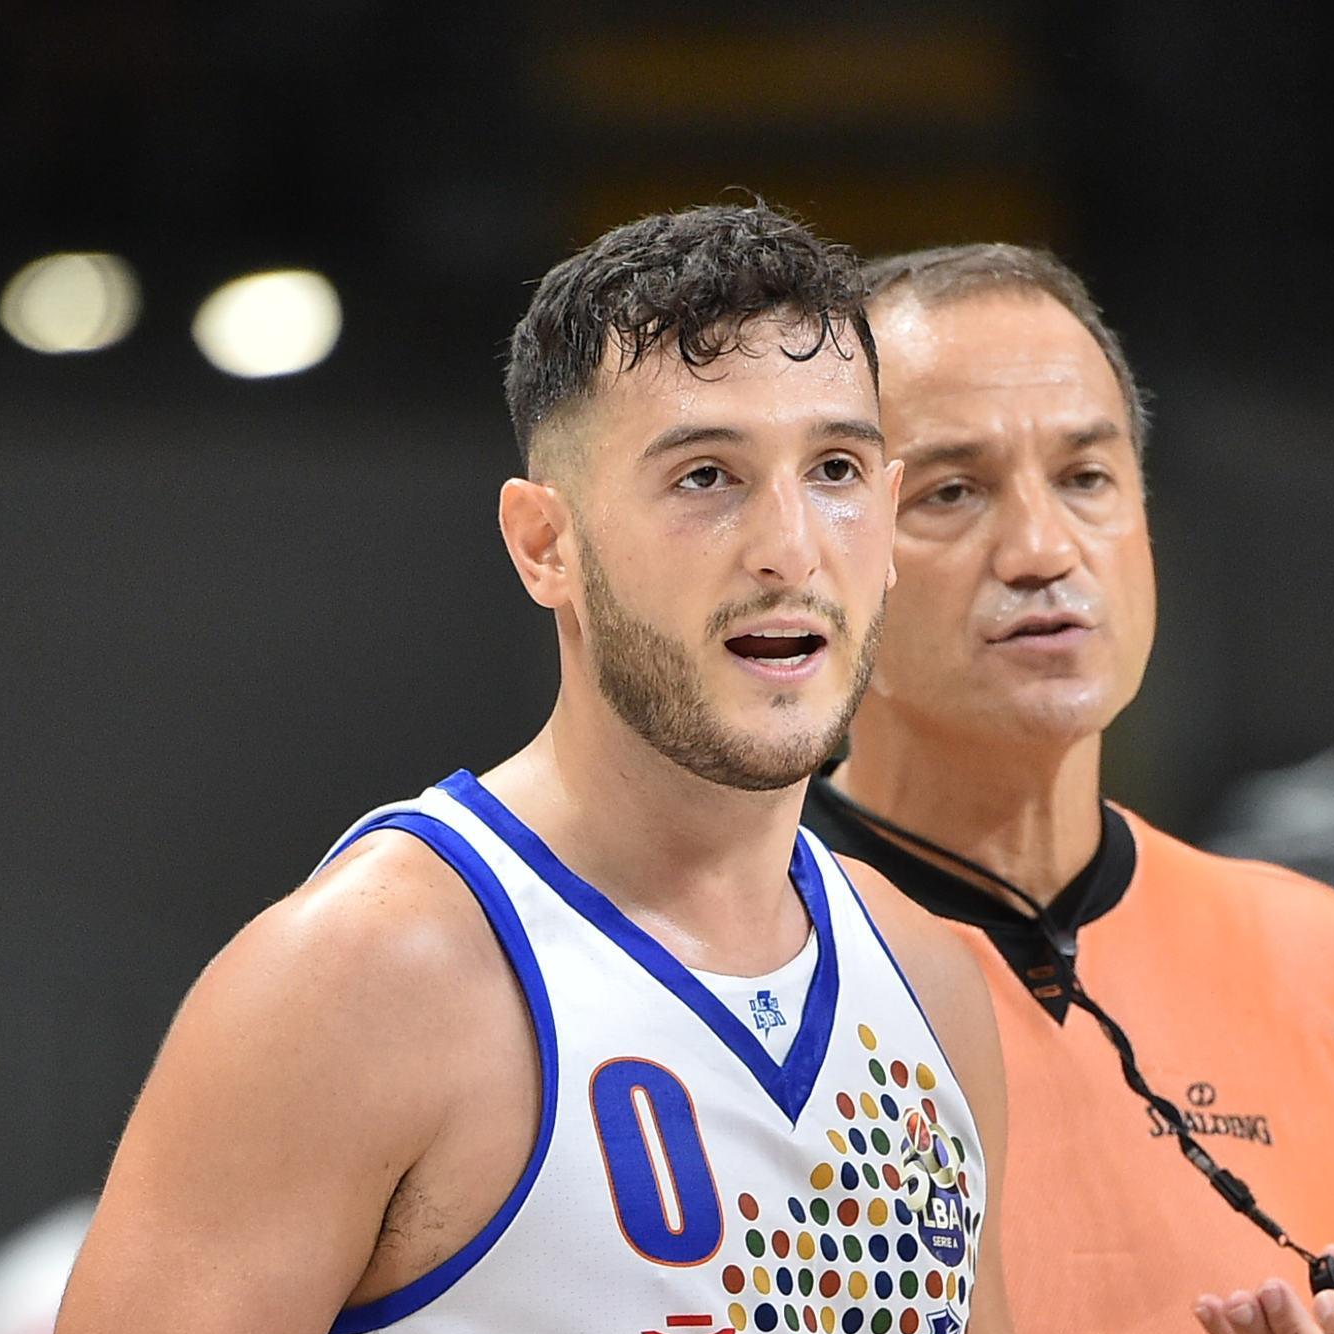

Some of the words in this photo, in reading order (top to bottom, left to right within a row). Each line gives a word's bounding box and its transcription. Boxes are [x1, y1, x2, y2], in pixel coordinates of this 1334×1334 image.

[589, 1056, 724, 1267] 0
[922, 1197, 962, 1232] LBA
[932, 1235, 952, 1249] SERIE
[953, 1238, 959, 1249] A
